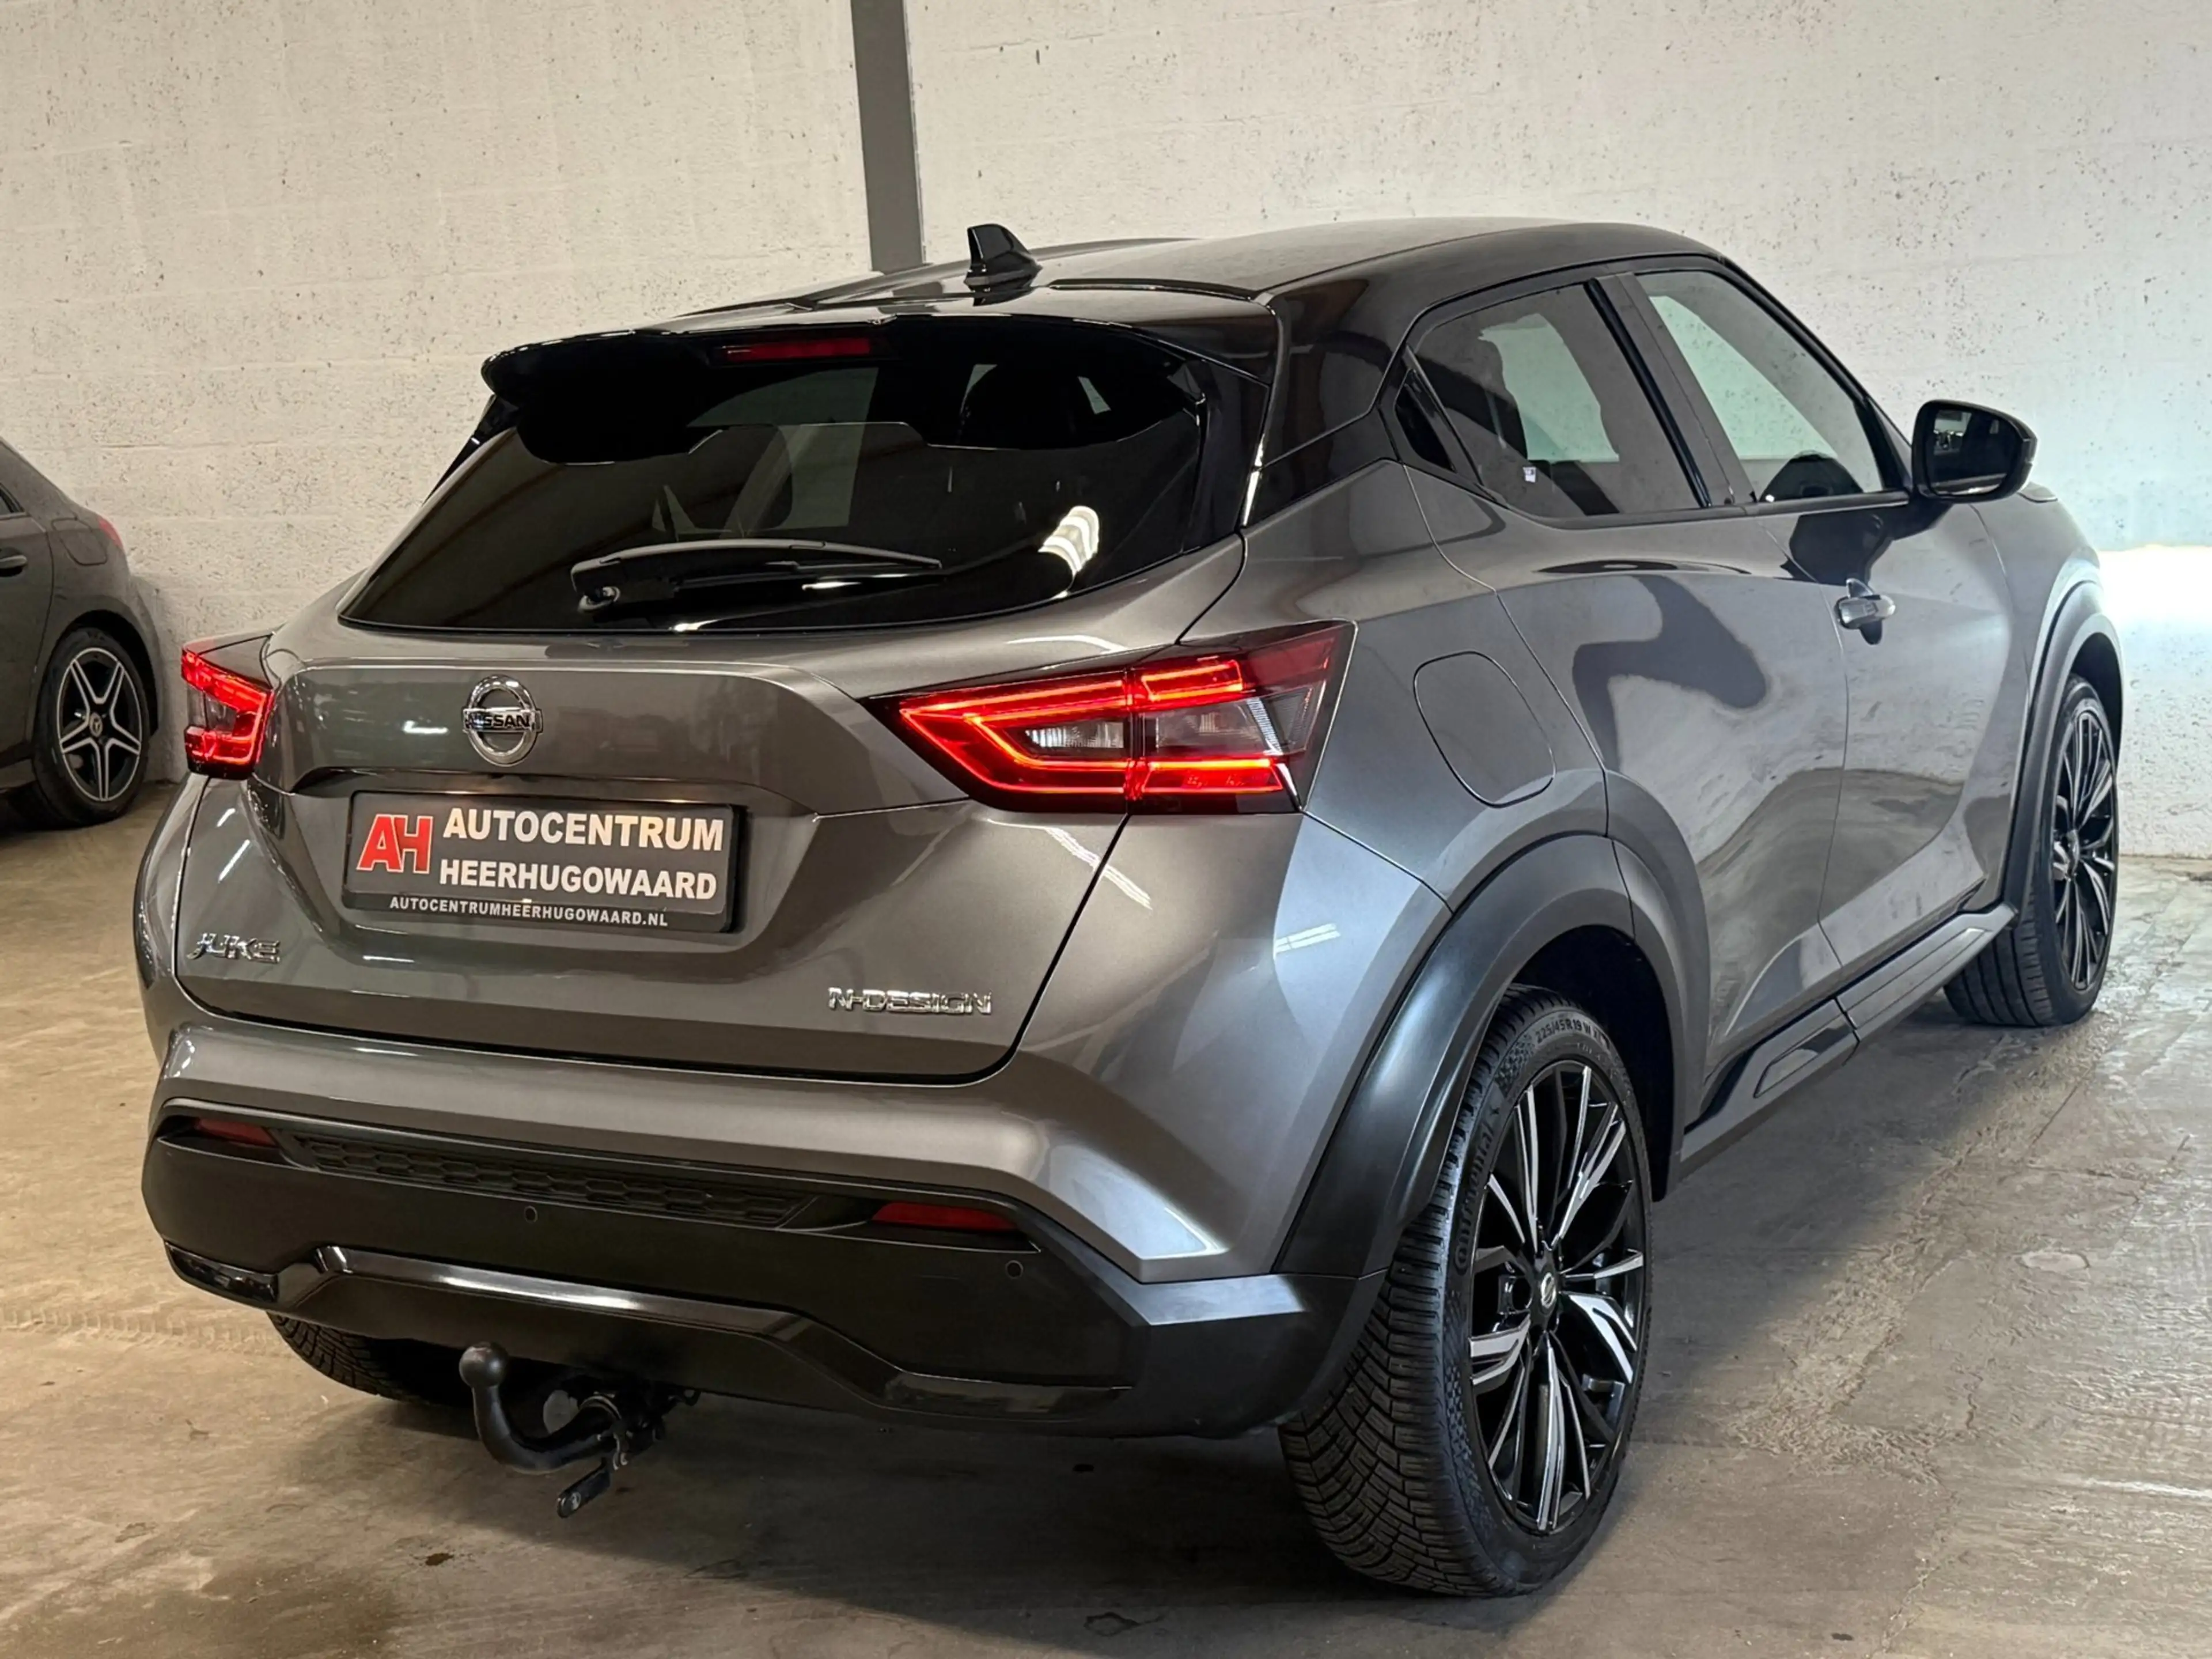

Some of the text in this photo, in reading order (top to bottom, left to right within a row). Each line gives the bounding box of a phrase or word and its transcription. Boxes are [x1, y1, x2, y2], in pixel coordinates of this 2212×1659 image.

[465, 713, 531, 729] NISSAN
[356, 814, 434, 874] AH
[442, 808, 724, 851] AUTOCENTRUM
[439, 858, 718, 900] HEERHUGOWAARD
[389, 896, 669, 926] AUTOCENTRUMHEERHUGOWAARD.NL
[828, 987, 993, 1014] N-DESIGN
